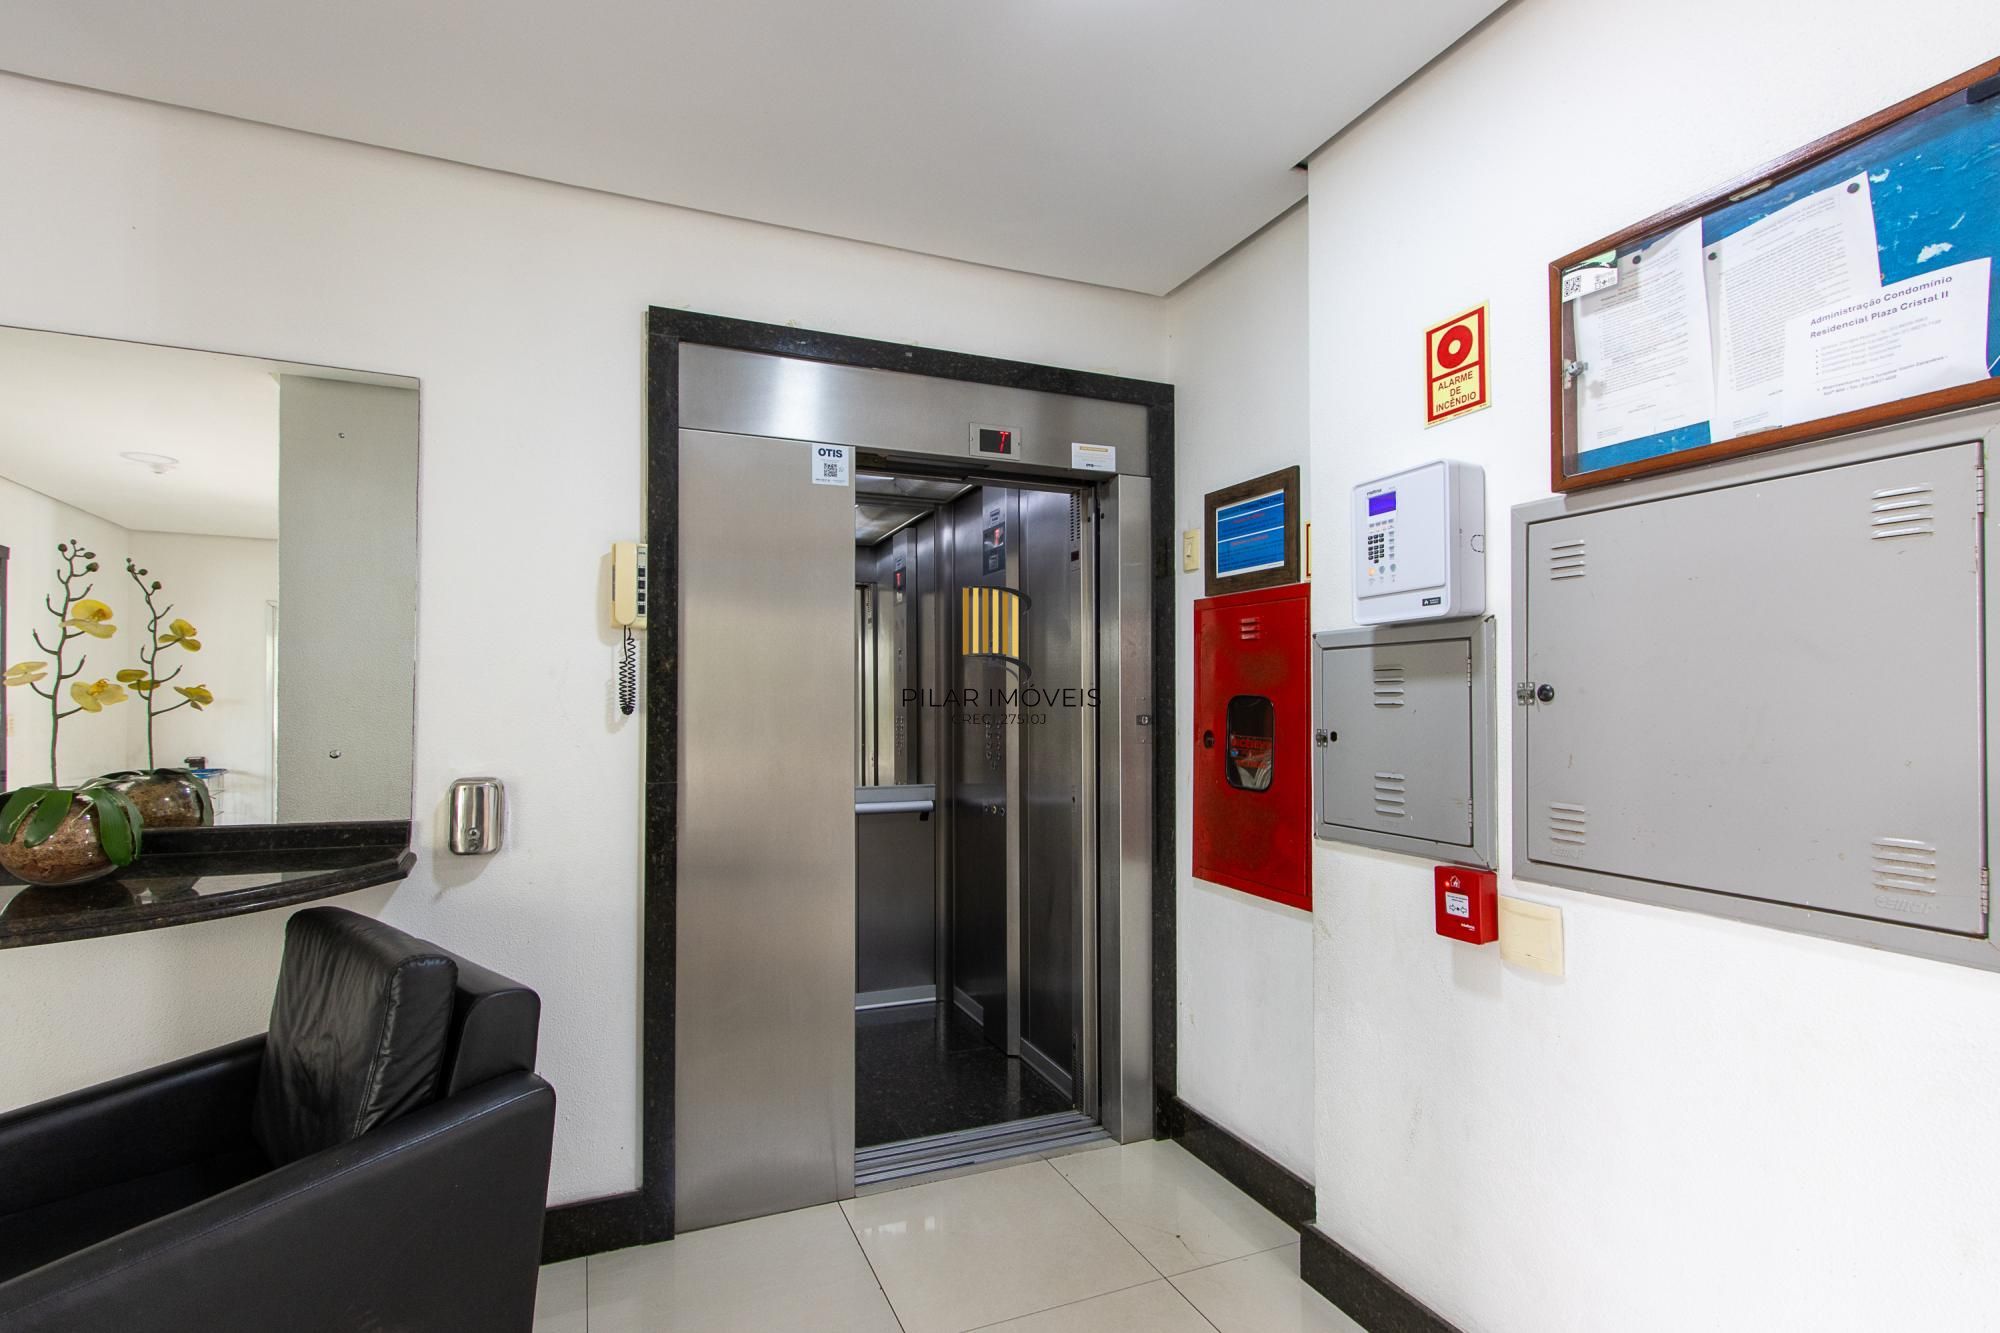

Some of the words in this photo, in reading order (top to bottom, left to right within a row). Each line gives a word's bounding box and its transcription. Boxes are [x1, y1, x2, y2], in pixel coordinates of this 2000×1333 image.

[1810, 298, 1881, 326] Administração
[1883, 276, 1953, 301] Condomínio
[1810, 316, 1868, 338] Residencial
[1871, 307, 1898, 320] Plaza
[1900, 293, 1938, 311] Cristal
[1941, 290, 1949, 299] II
[1438, 371, 1473, 391] ALARME
[1449, 386, 1462, 397] DE
[1436, 391, 1477, 412] INCÊNDIO
[818, 448, 843, 458] OTIS
[1000, 431, 1009, 454] 7
